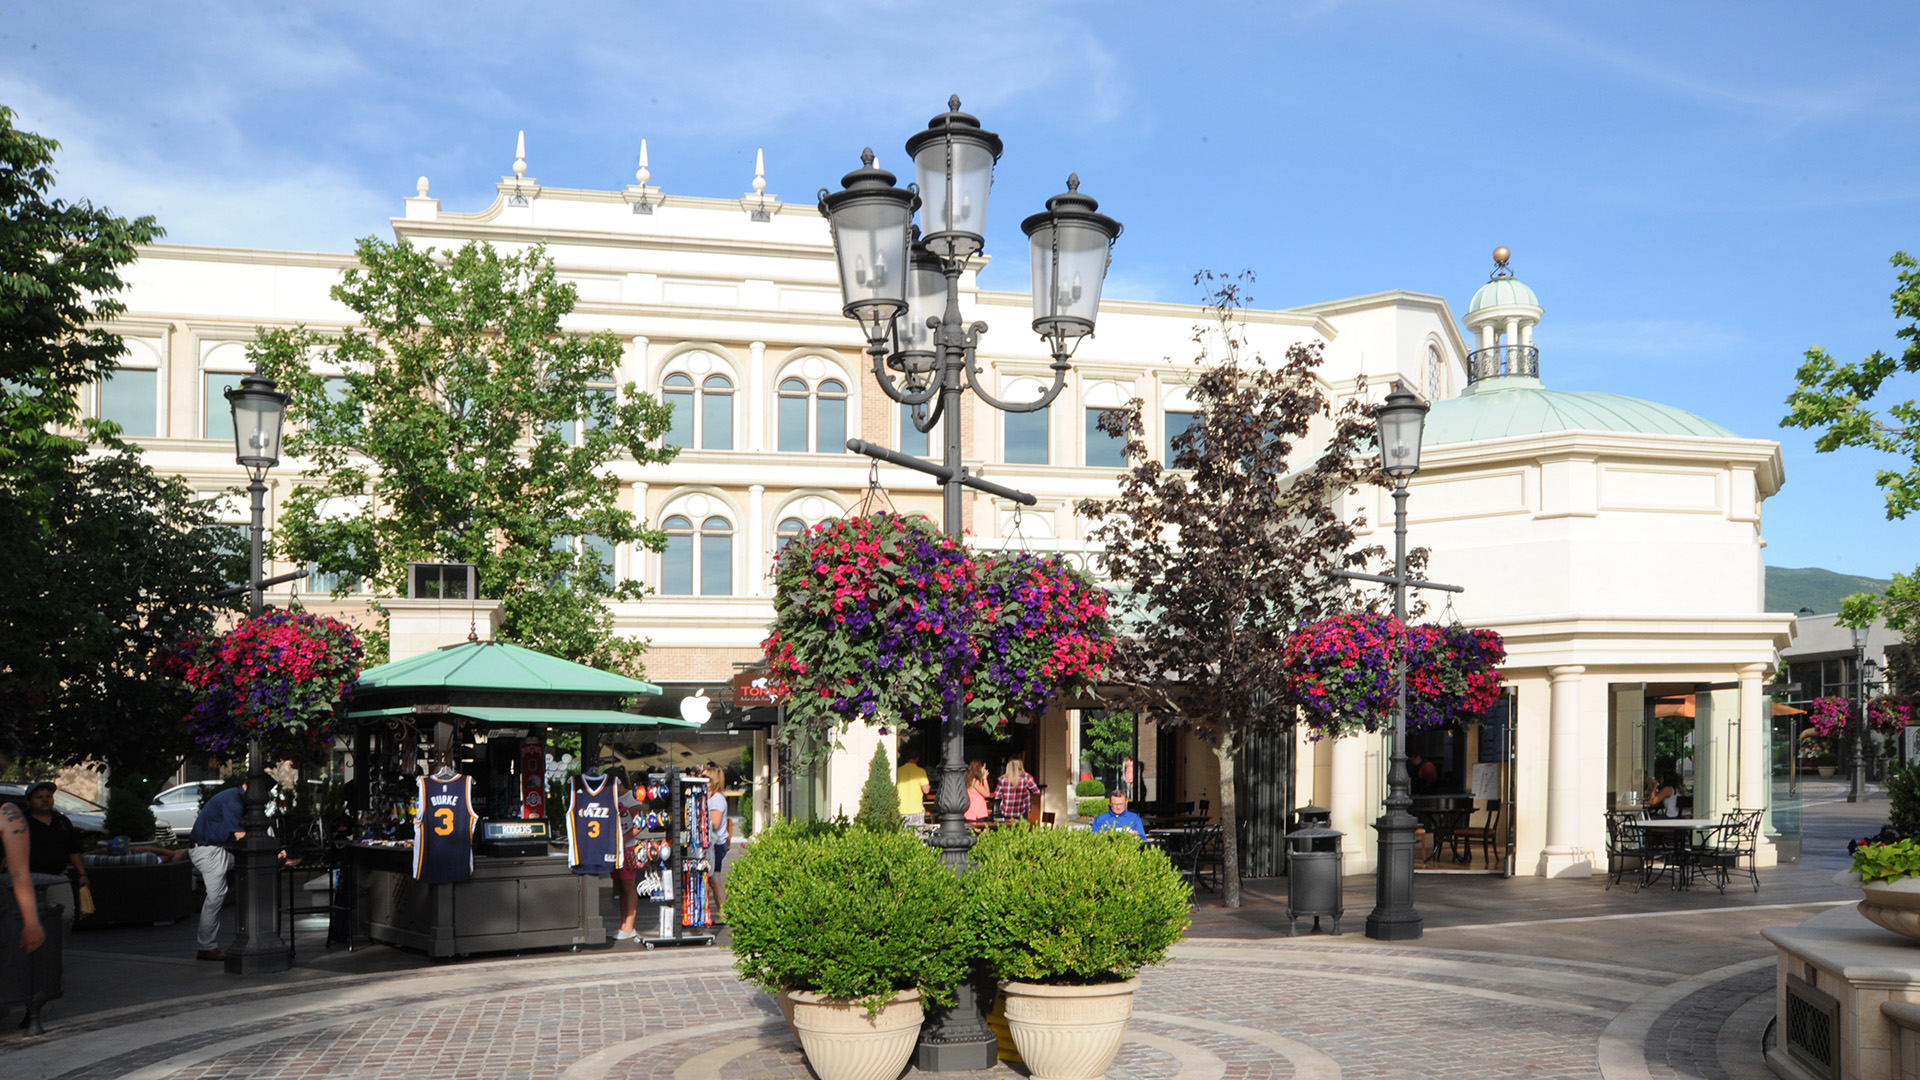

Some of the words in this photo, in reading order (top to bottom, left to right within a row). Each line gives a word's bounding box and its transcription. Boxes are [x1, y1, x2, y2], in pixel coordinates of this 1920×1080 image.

[430, 795, 459, 807] BURKE
[578, 802, 610, 818] JAZZ
[434, 808, 454, 836] 3
[587, 820, 600, 838] 3
